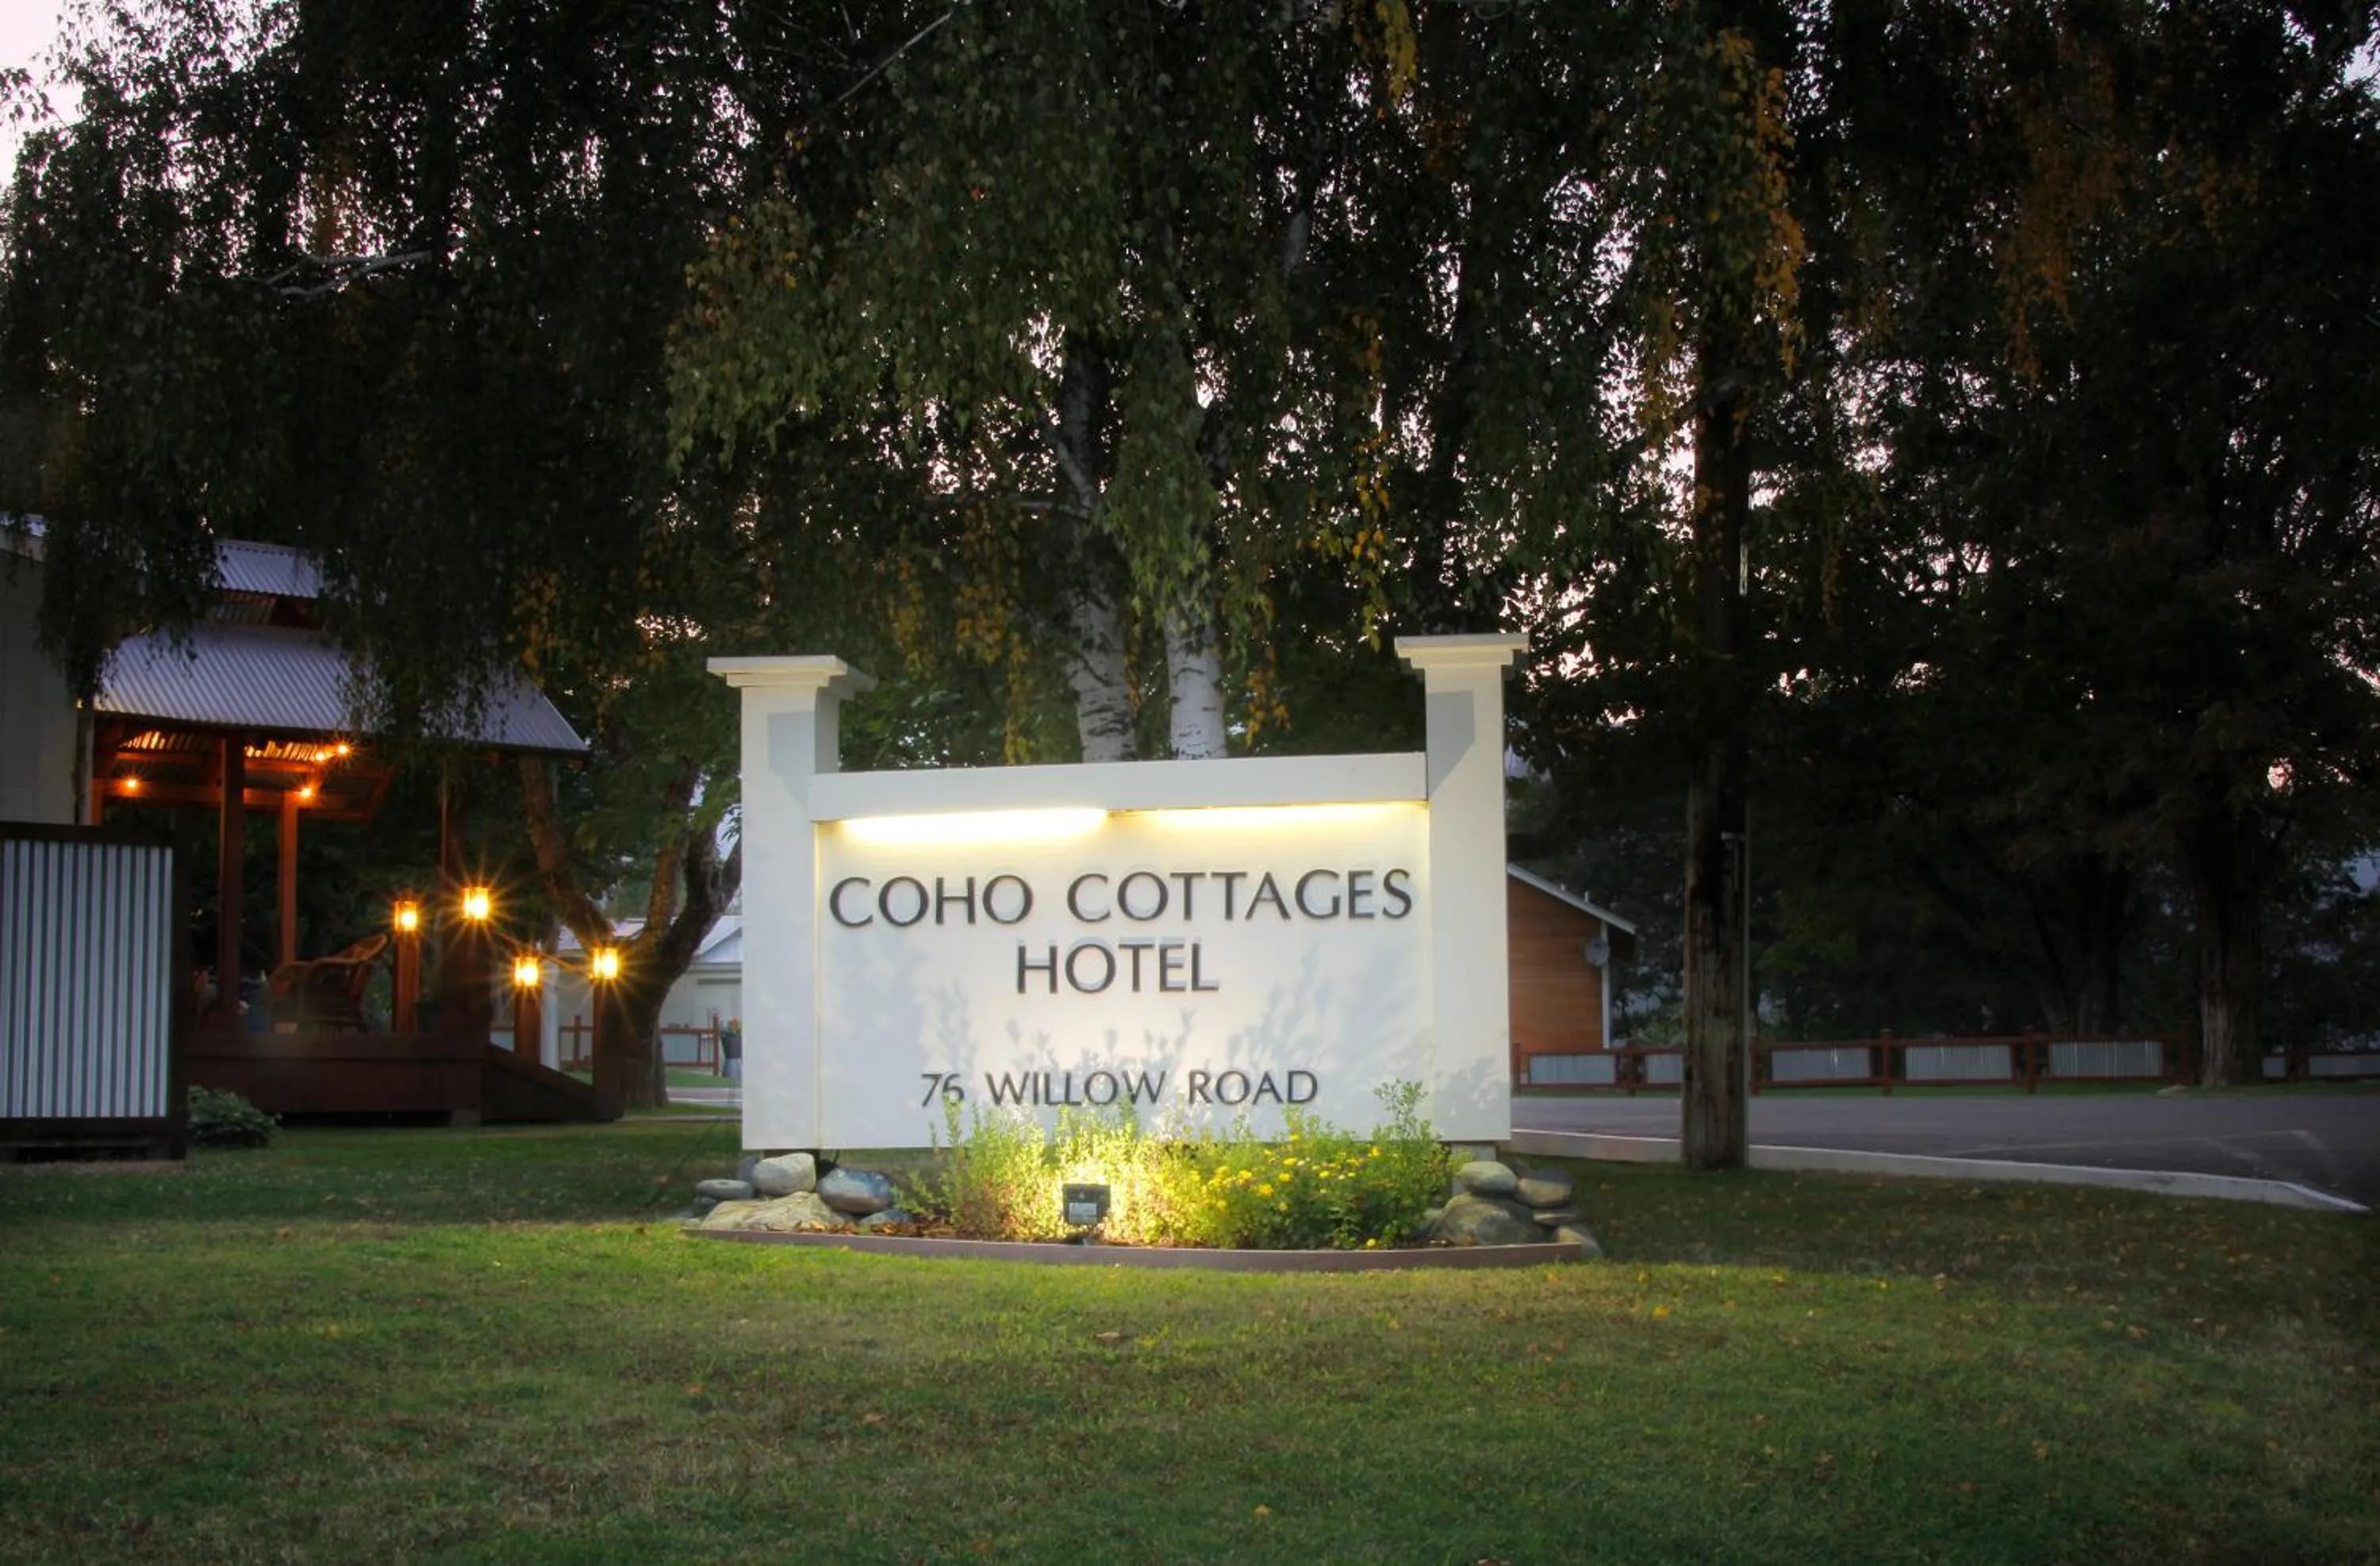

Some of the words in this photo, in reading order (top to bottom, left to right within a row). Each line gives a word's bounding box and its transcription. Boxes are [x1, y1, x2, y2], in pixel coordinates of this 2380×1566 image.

[829, 874, 1034, 927] COHO
[1066, 869, 1413, 923] COTTAGES
[1016, 942, 1219, 993] HOTEL
[920, 1073, 965, 1107] 76
[985, 1069, 1167, 1106] WILLOW
[1188, 1069, 1319, 1105] ROAD
